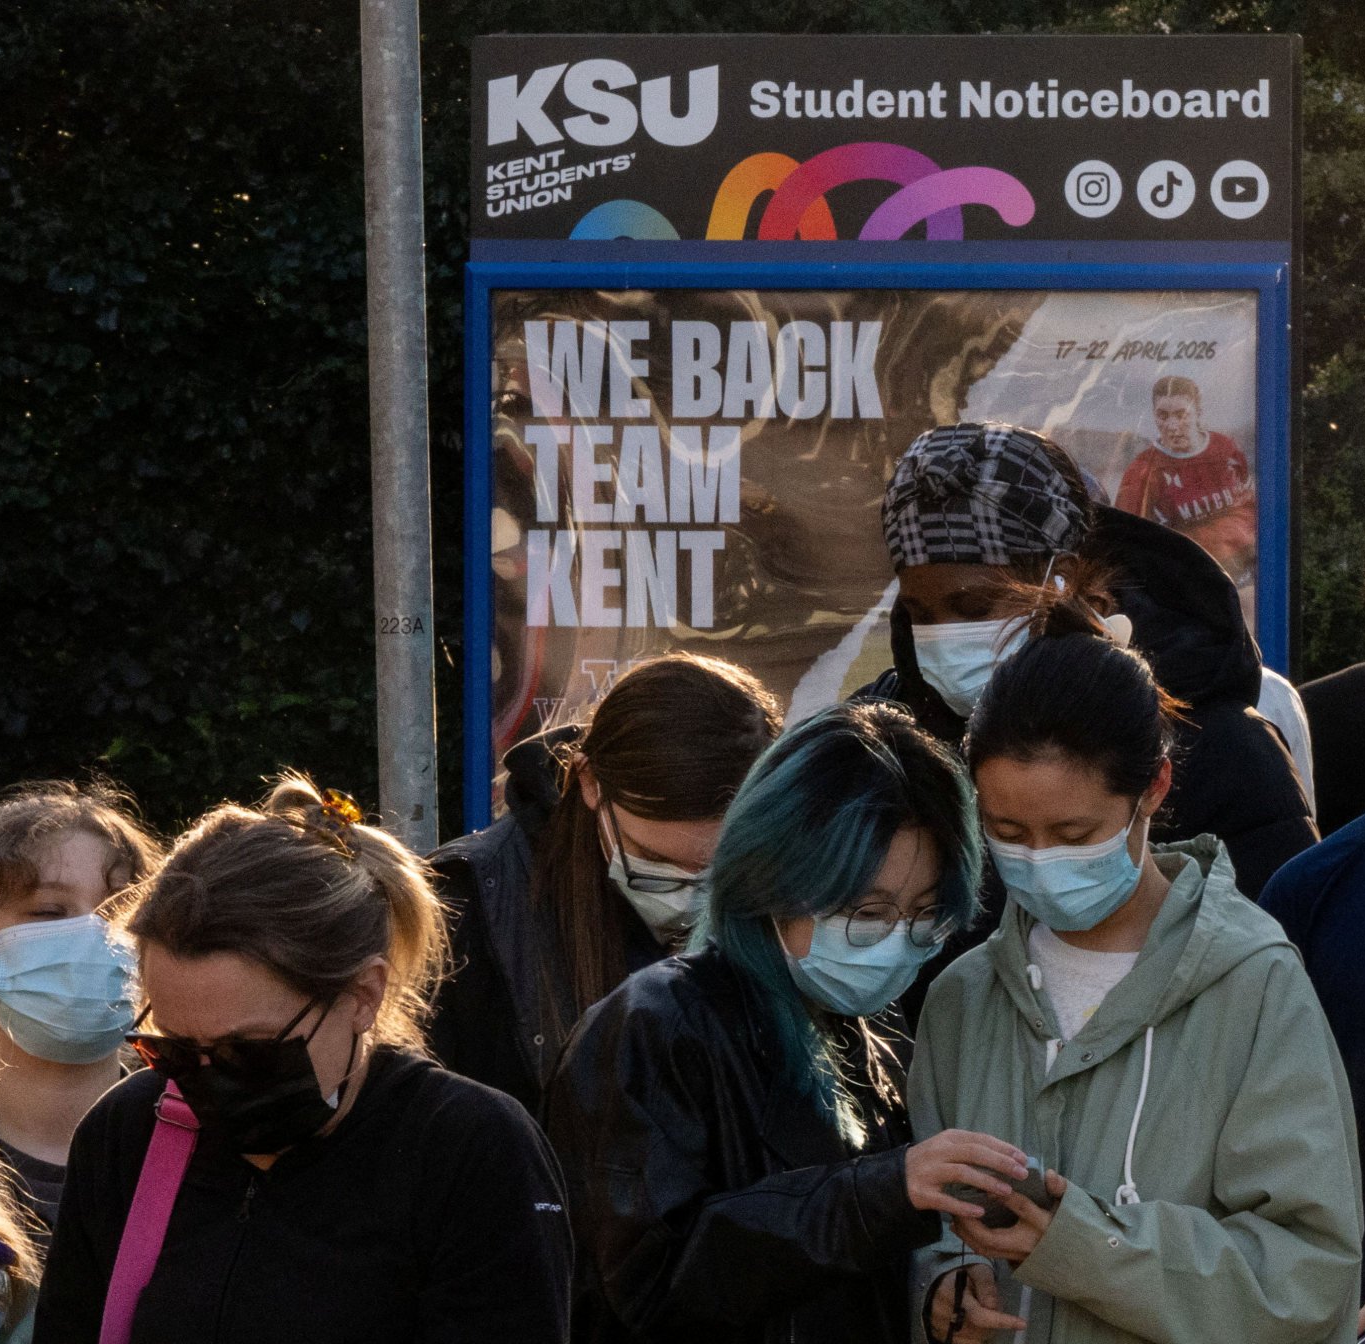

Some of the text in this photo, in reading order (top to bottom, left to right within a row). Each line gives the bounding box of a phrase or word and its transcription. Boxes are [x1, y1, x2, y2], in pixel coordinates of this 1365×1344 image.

[488, 58, 719, 146] KSU
[750, 79, 1270, 118] Student Noticeboard
[486, 152, 635, 201] STUDENTS'
[487, 149, 565, 182] KENT
[486, 185, 571, 218] UNION
[524, 320, 884, 419] WE BACK
[1112, 340, 1170, 362] APRIL
[1173, 340, 1218, 360] 2026
[524, 425, 741, 524] TEAM
[526, 530, 726, 628] KENT
[380, 617, 425, 634] 223A
